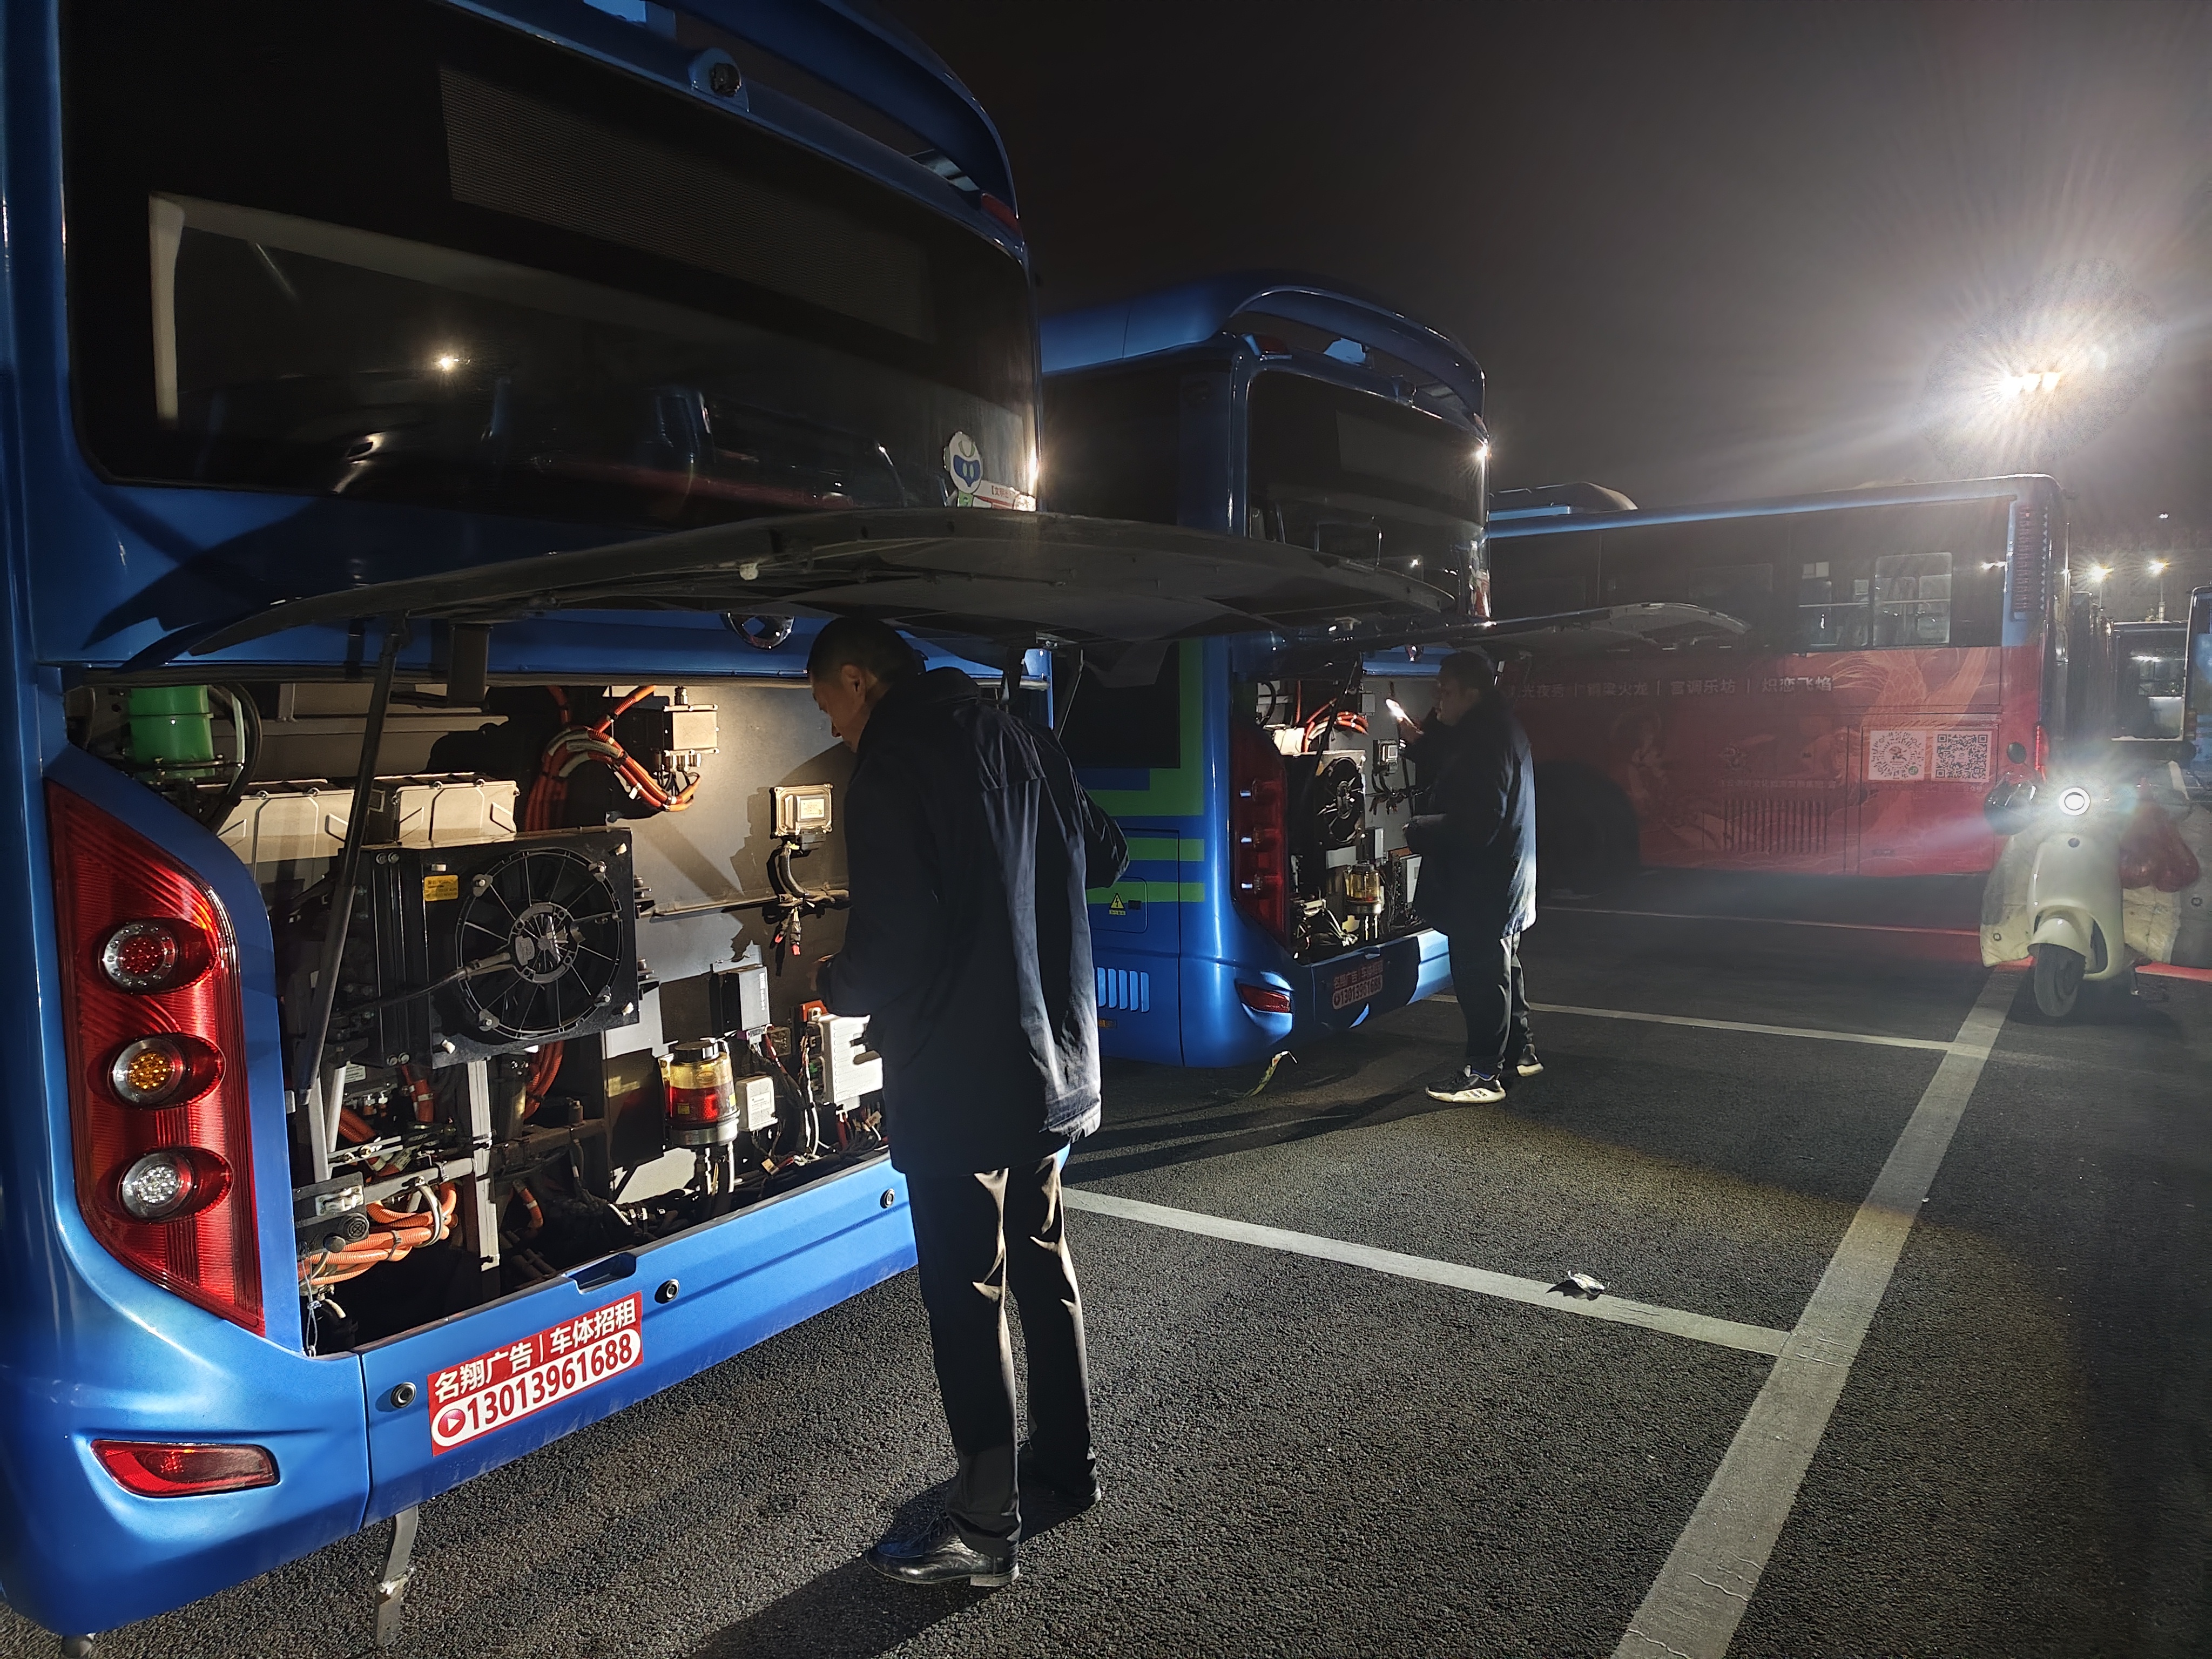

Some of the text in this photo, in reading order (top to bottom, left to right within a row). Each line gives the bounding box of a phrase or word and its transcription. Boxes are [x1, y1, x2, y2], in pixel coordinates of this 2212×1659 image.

[1762, 676, 1832, 693] 炽恋飞焰
[435, 1298, 636, 1403] 名翔广告 车体招租
[467, 1333, 632, 1430] 13013961688
